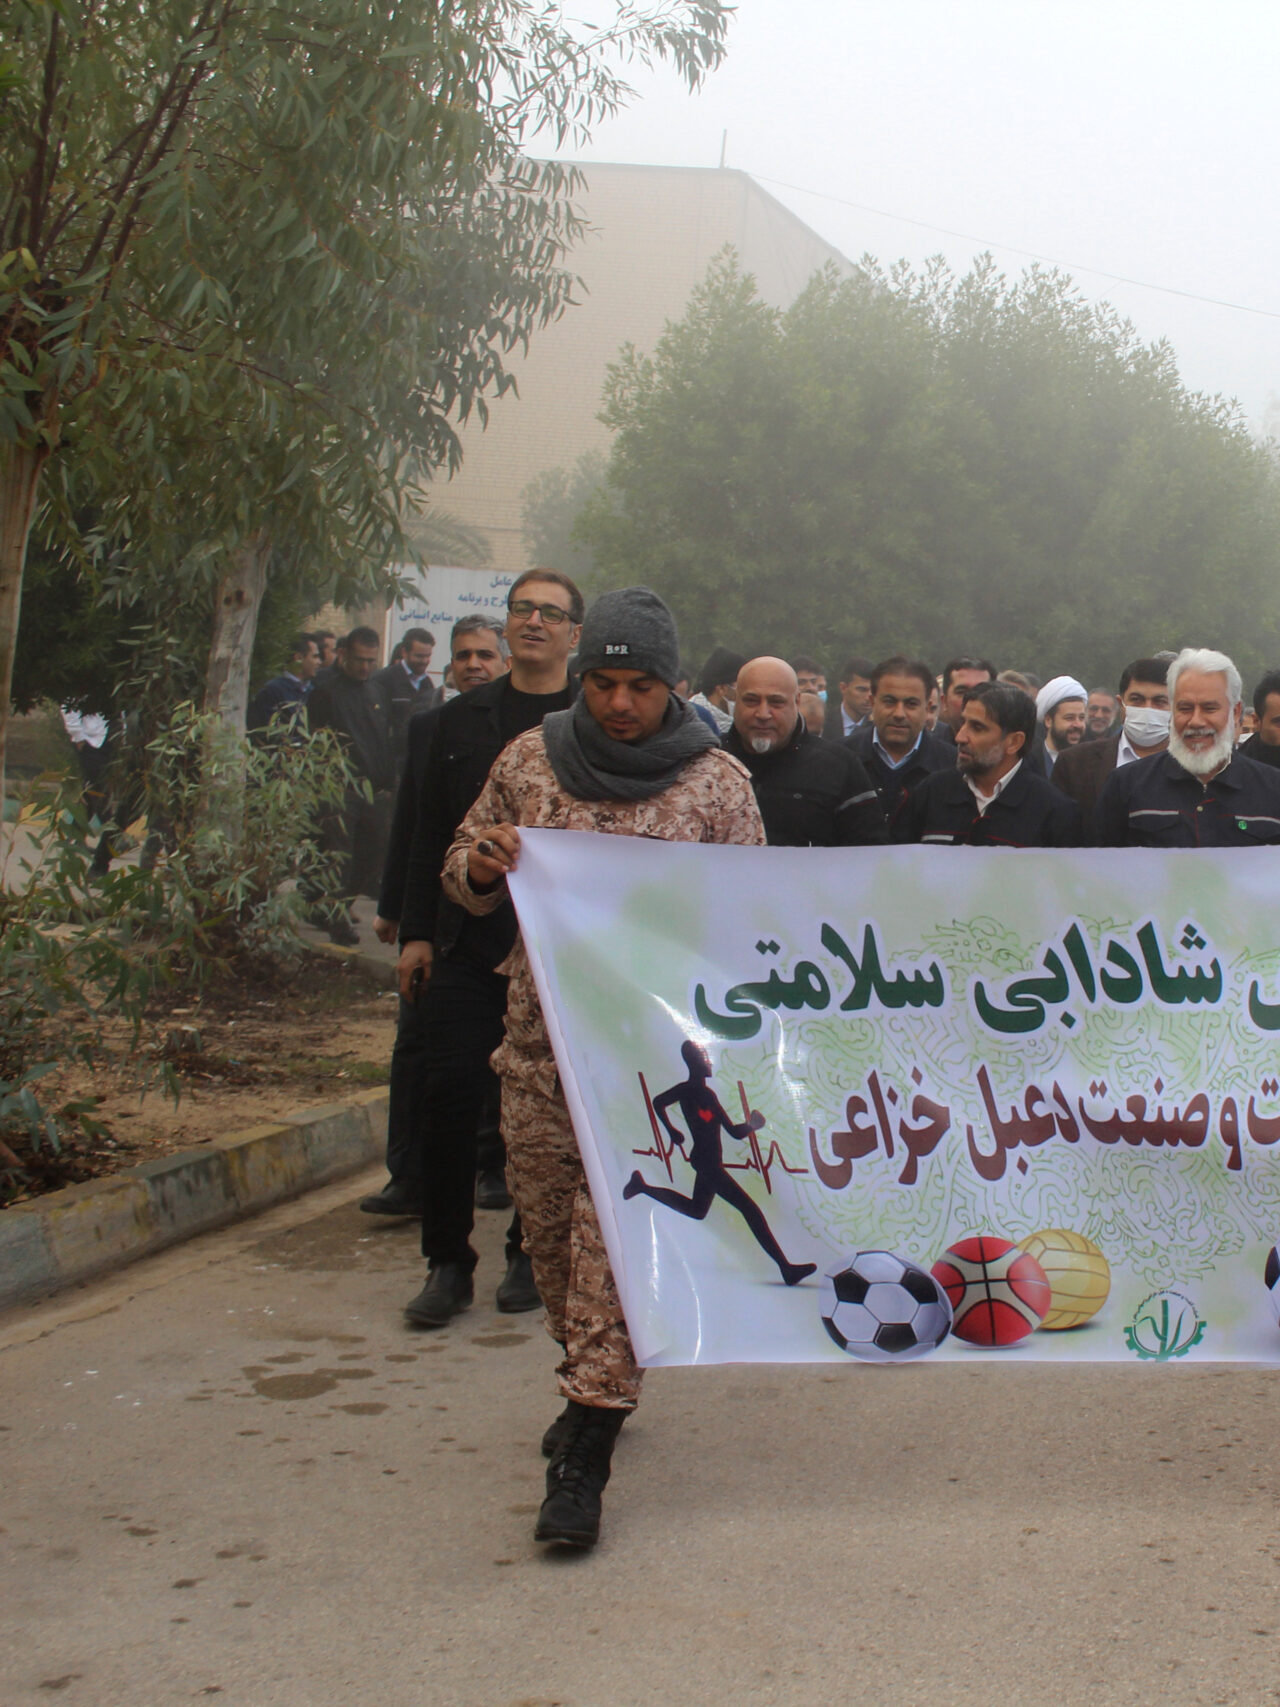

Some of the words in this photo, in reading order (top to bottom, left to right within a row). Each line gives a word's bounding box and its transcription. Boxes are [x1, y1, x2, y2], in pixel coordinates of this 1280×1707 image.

[694, 922, 945, 1041] سلامتی
[974, 921, 1223, 1033] شادابی
[809, 1066, 950, 1190] خزاعی
[966, 1064, 1081, 1181] دعبل
[1078, 1077, 1210, 1147] صنعت
[1219, 1097, 1242, 1171] و
